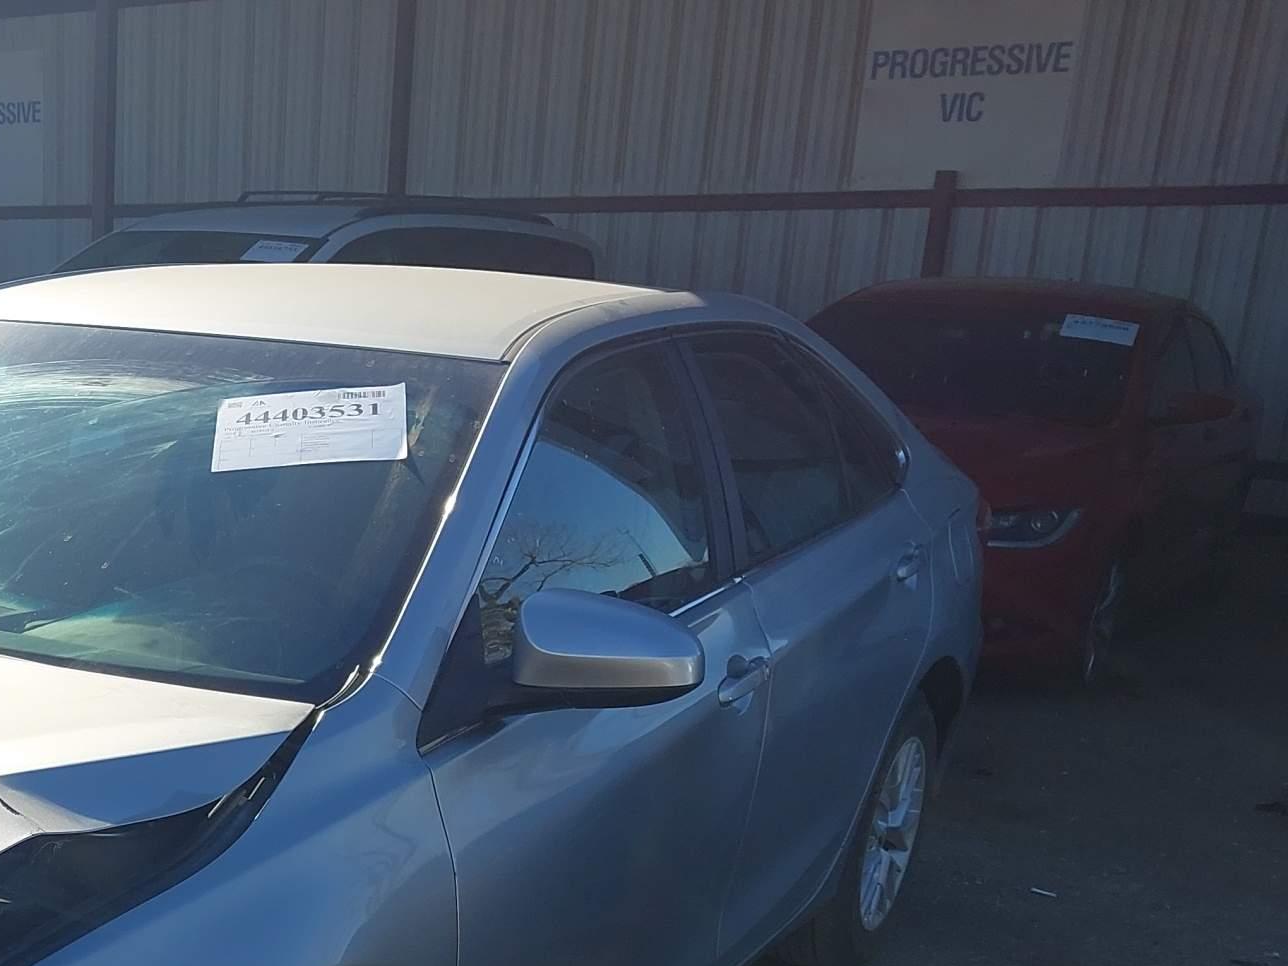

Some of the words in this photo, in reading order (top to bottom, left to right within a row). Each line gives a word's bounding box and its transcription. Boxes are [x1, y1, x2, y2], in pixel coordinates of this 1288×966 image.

[870, 41, 1073, 80] PROGRESSIVE
[939, 92, 985, 122] VIC
[236, 402, 382, 425] 44403531
